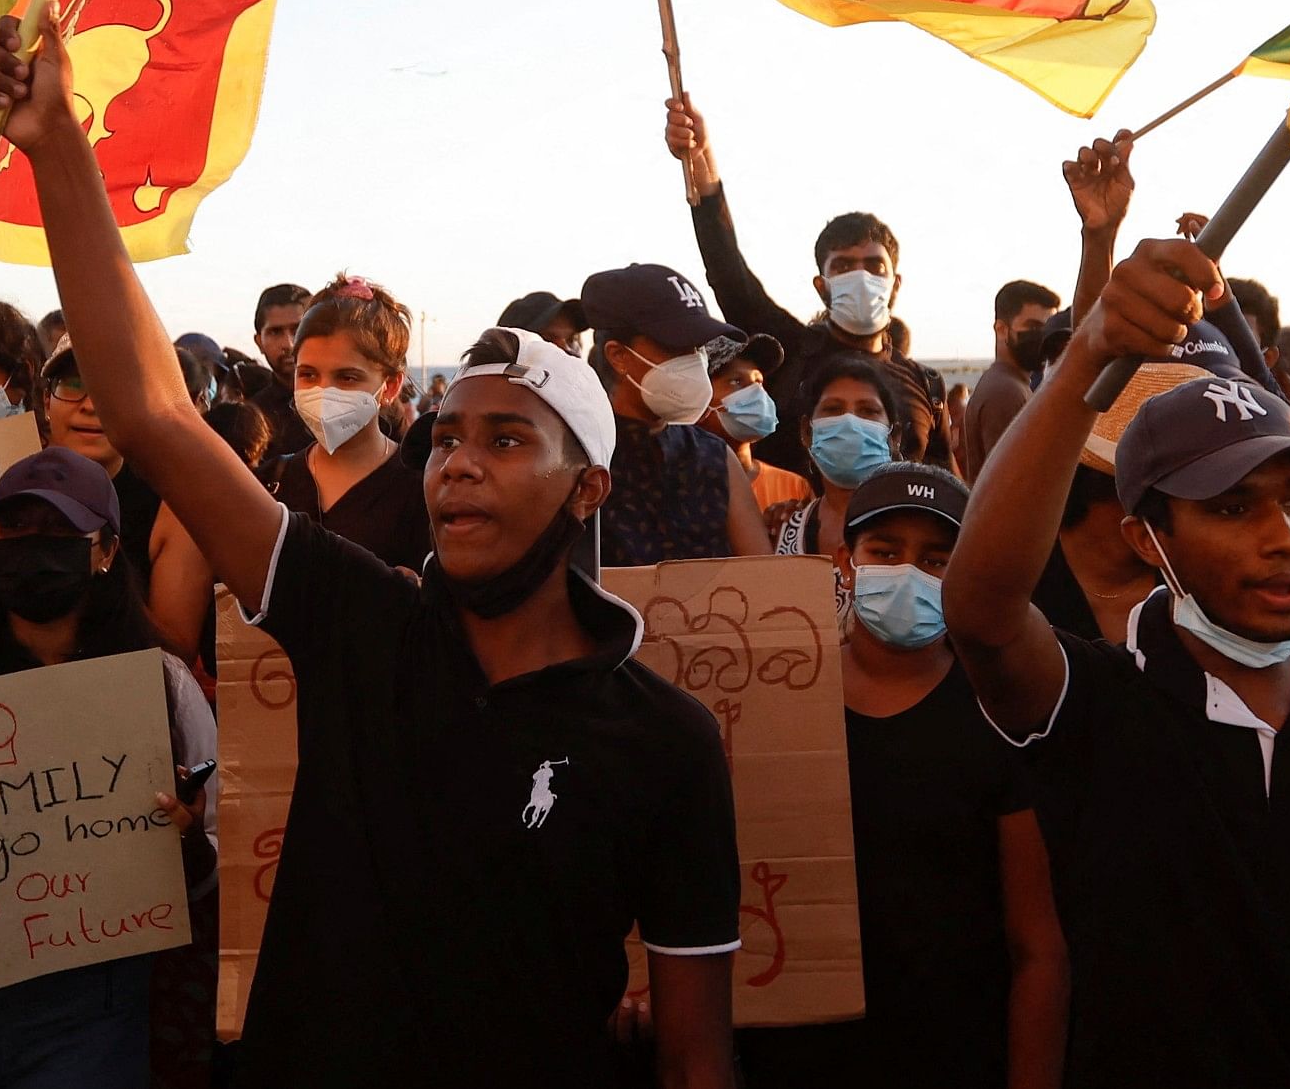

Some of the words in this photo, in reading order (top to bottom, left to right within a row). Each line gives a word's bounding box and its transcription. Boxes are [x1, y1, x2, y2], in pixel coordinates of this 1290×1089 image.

[666, 275, 704, 309] LA
[1203, 380, 1268, 422] NY
[907, 484, 935, 499] WH
[65, 807, 172, 842] home
[22, 902, 174, 960] Future
